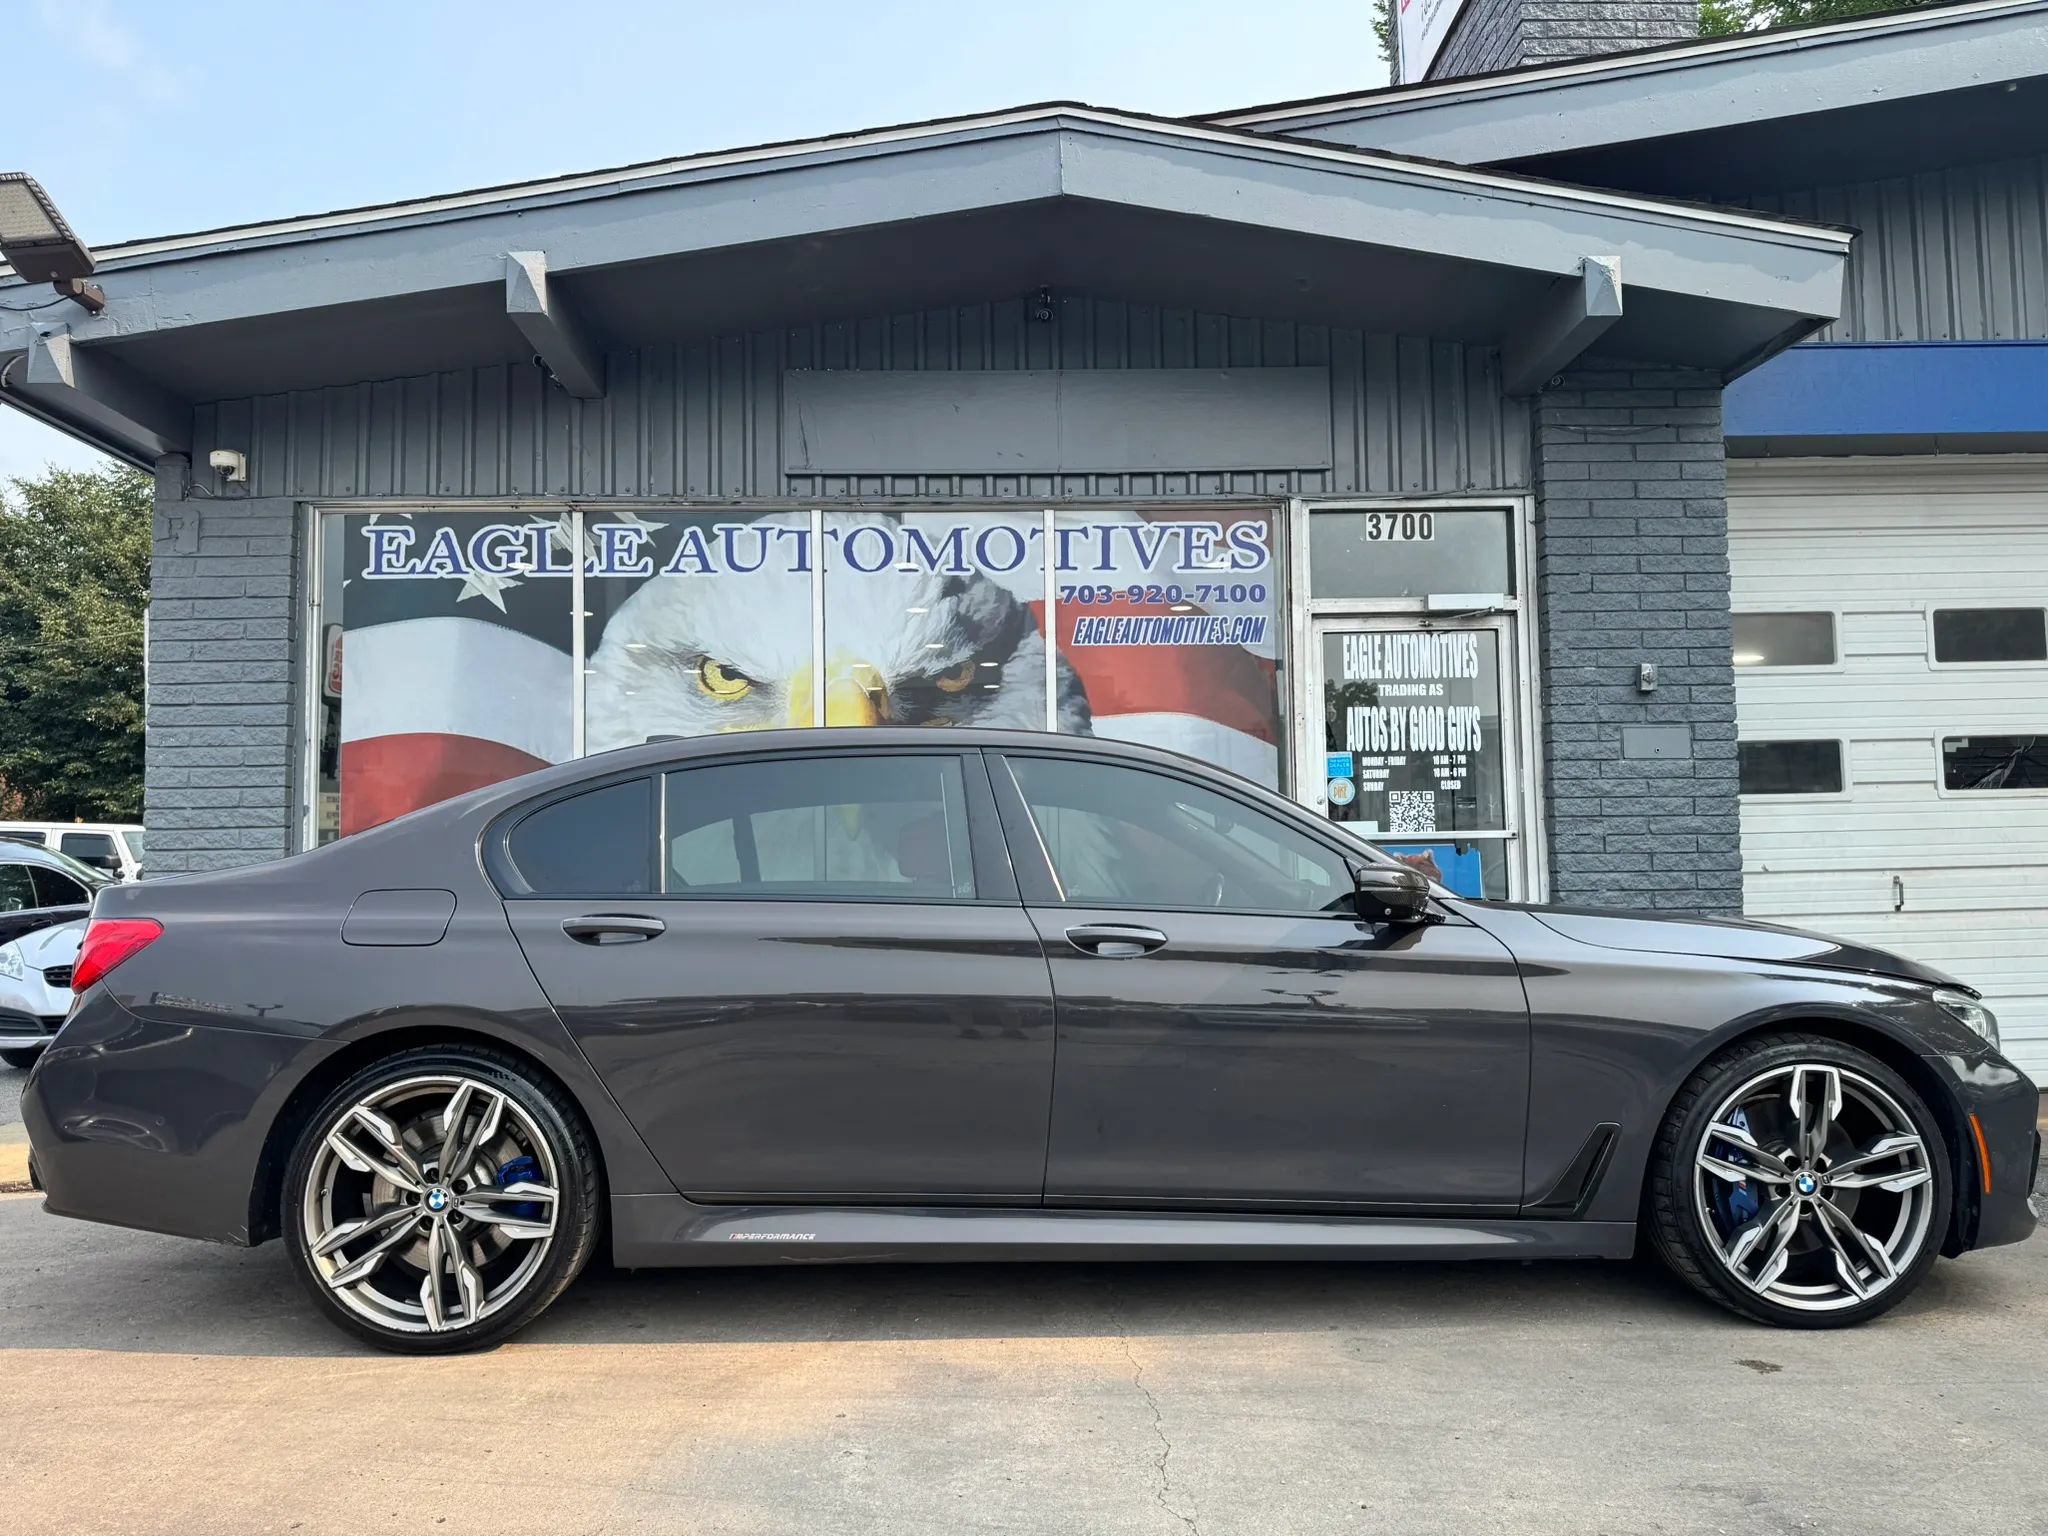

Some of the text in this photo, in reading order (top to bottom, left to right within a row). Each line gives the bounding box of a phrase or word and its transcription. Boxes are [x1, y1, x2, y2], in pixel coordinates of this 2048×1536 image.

[1368, 513, 1432, 540] 3700
[363, 520, 1271, 580] EAGLE AUTOMOTIVES
[1060, 584, 1267, 606] 703-920-7100
[1072, 615, 1267, 646] EAGLEAUTOMOTIVES.COM
[1343, 633, 1478, 680] EAGLE AUTOMOTIVES
[1379, 684, 1443, 697] TRADING AS
[1346, 705, 1482, 752] AUTOS BY GOOD GUYS
[1362, 756, 1384, 766] MONDAY
[1387, 756, 1406, 766] FRIDAY
[1457, 755, 1467, 764] PM
[1362, 769, 1389, 779] SATURDAY
[1458, 768, 1467, 777] PM
[1363, 780, 1461, 791] SUNDAY CLOSED
